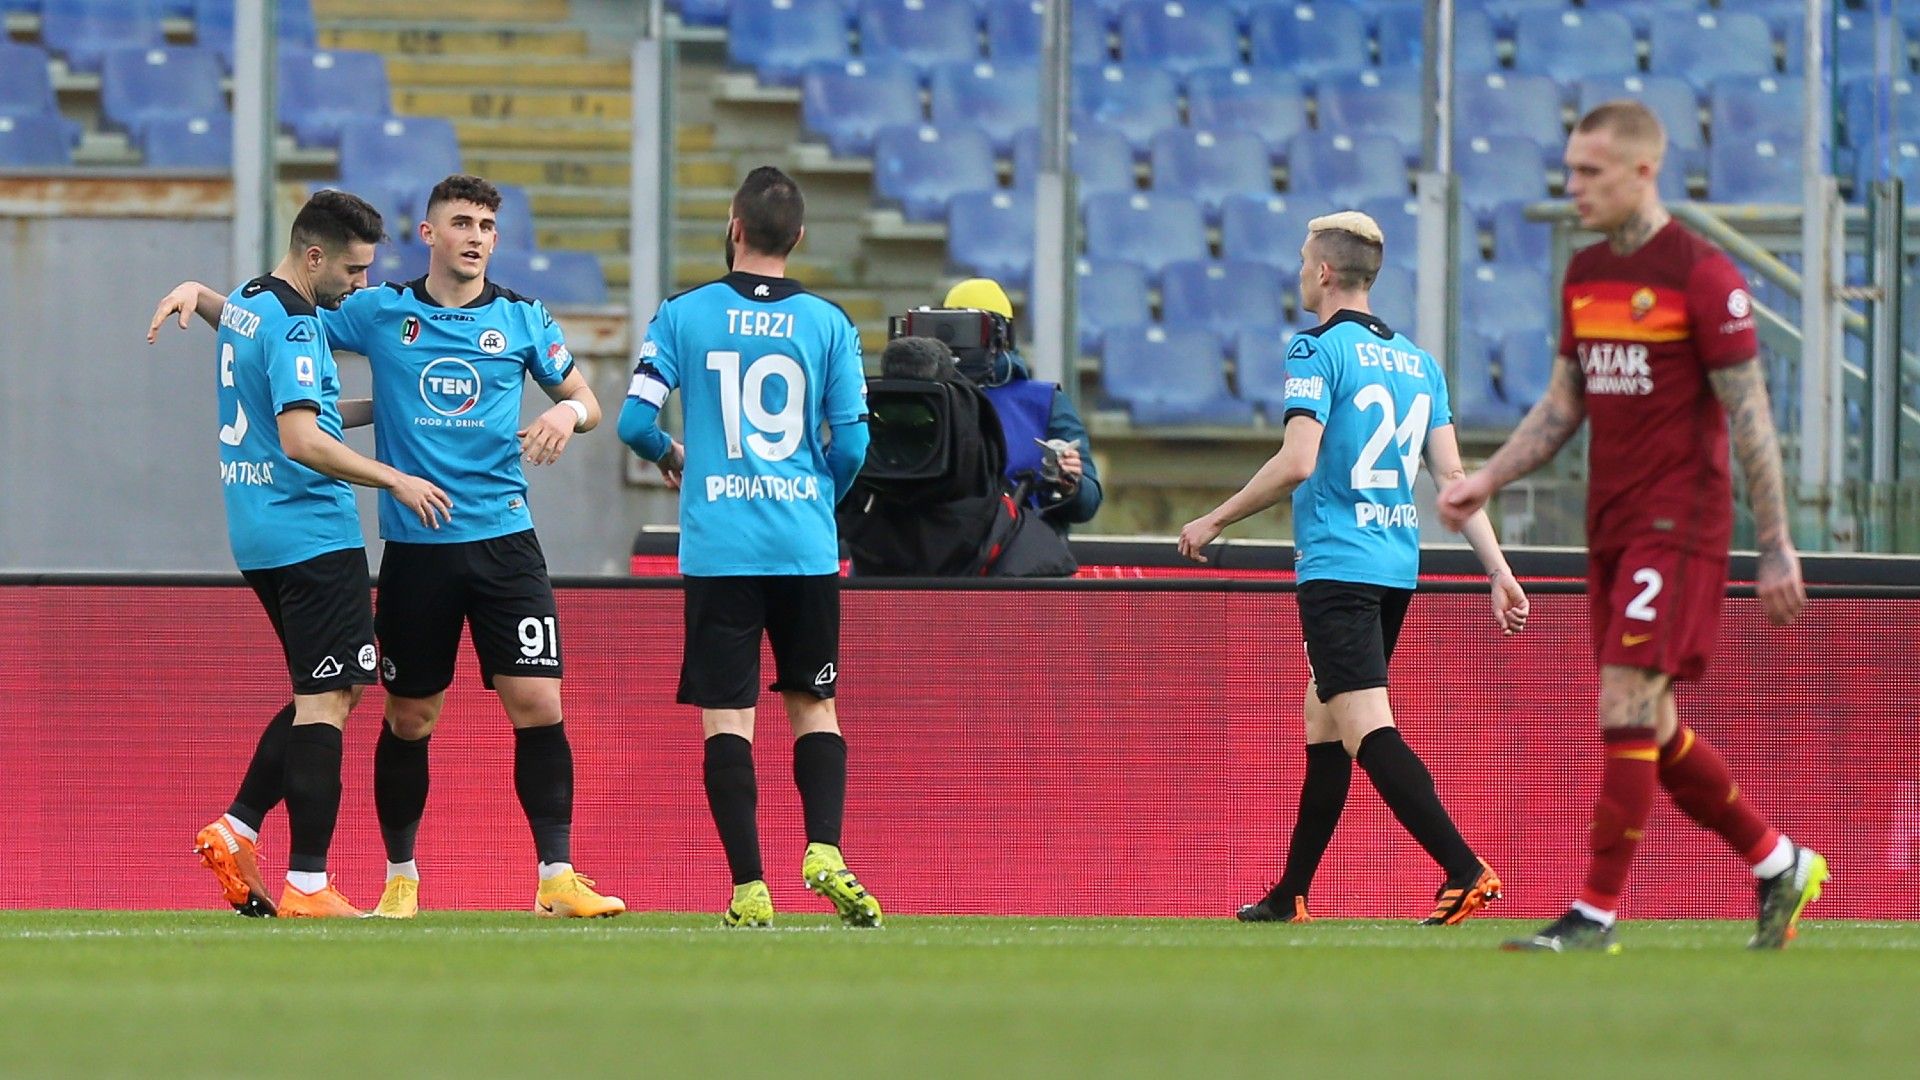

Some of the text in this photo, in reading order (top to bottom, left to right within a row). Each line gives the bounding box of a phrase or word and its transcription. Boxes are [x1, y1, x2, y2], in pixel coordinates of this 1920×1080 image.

[726, 309, 794, 339] TERZI
[428, 377, 473, 396] TEN
[706, 351, 807, 462] 19
[414, 417, 486, 428] FOOD & DRINK
[706, 474, 818, 502] PEDIATRICA
[1624, 567, 1664, 622] 2
[517, 616, 558, 658] 91
